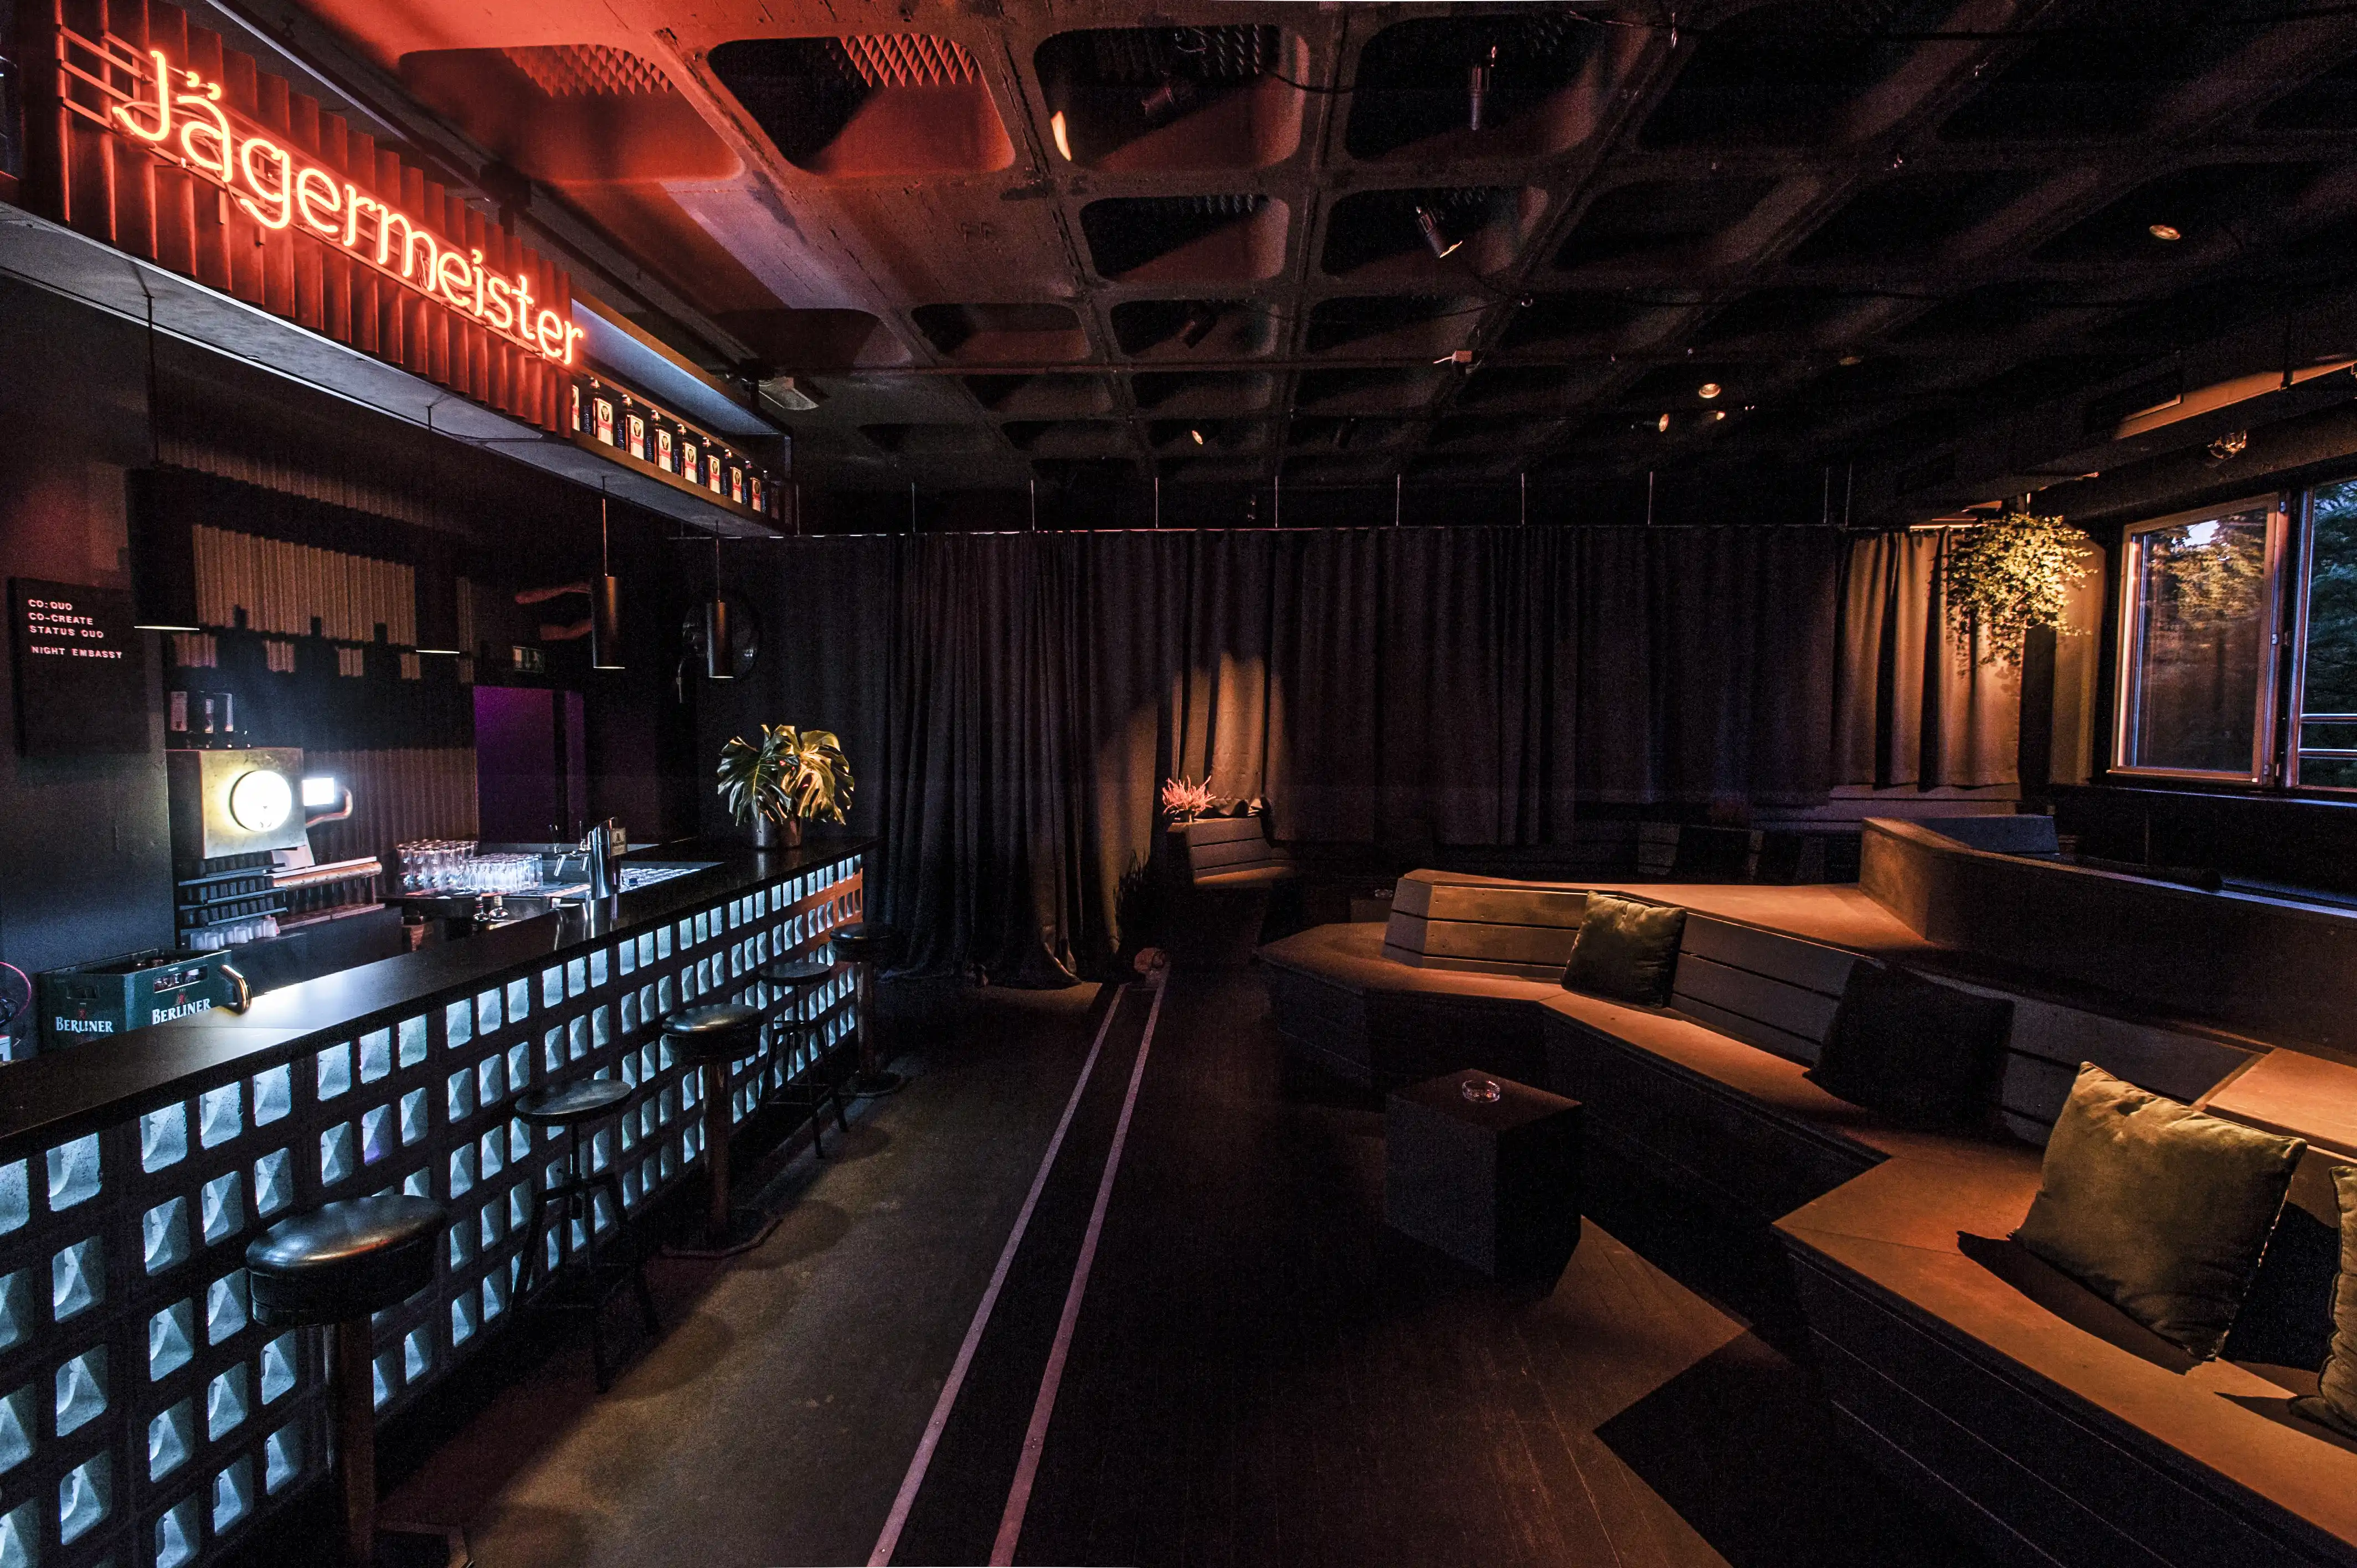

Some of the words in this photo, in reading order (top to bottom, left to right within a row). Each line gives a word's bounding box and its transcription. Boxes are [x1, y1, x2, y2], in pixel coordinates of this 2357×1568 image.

[112, 49, 584, 365] Jägermeister
[28, 612, 93, 625] CO-CREATE
[29, 625, 75, 636] STATUS
[80, 629, 104, 638] QUO
[31, 645, 65, 656] NIGHT
[71, 648, 123, 659] EMBASSY
[152, 998, 211, 1025] BERLINER
[55, 1016, 114, 1033] BERLINER
